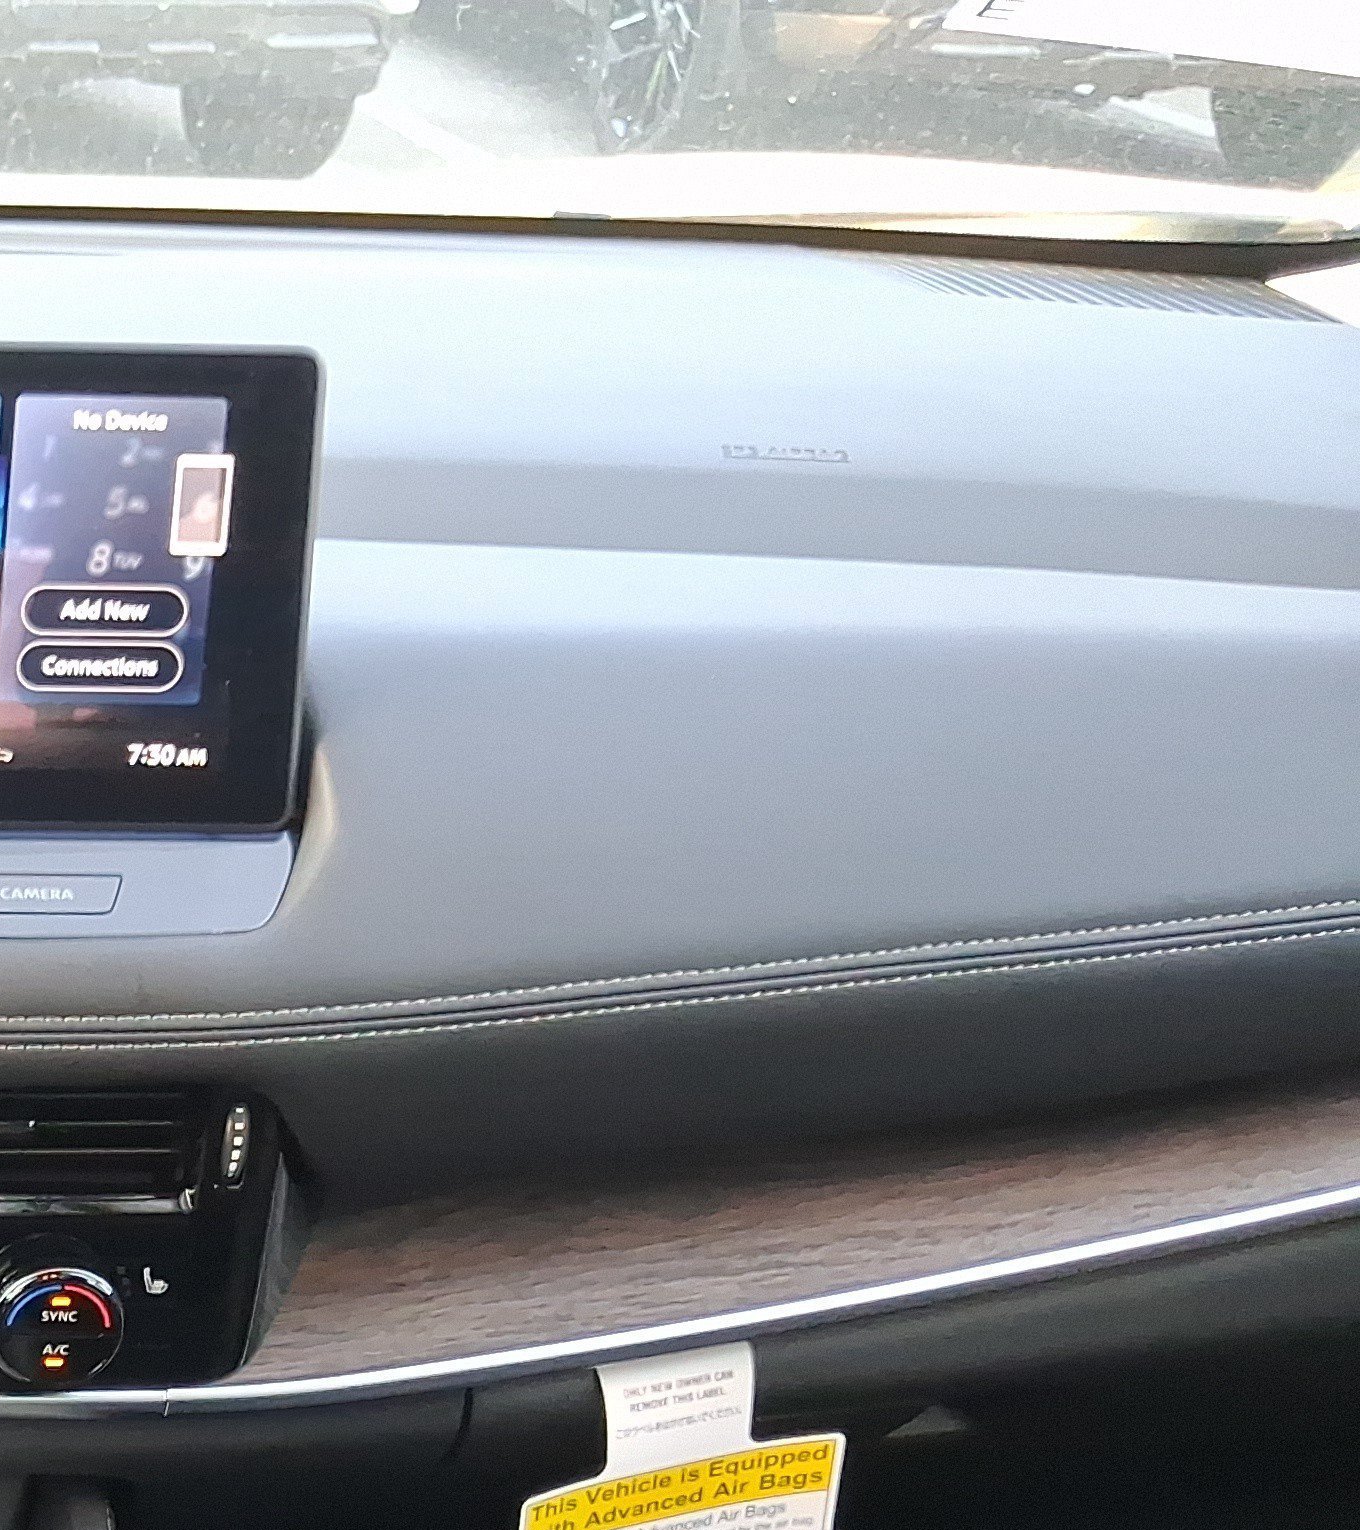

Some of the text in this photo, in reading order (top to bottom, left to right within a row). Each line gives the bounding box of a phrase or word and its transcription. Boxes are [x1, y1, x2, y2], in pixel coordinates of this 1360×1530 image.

[73, 409, 169, 431] No Device
[86, 539, 114, 577] 8
[60, 598, 151, 622] Add New
[41, 654, 159, 678] Connections
[127, 743, 208, 767] 7:30 AM
[0, 887, 74, 902] CAMERA
[40, 1311, 78, 1323] SYNC
[42, 1344, 70, 1356] A/C
[532, 1497, 577, 1523] This
[586, 1475, 672, 1510] Vehicle
[708, 1444, 829, 1478] Equipped
[584, 1487, 703, 1528] Advanced
[713, 1479, 748, 1500] Air
[759, 1468, 823, 1491] Bags
[718, 1507, 743, 1523] Air
[744, 1502, 786, 1519] Bags
